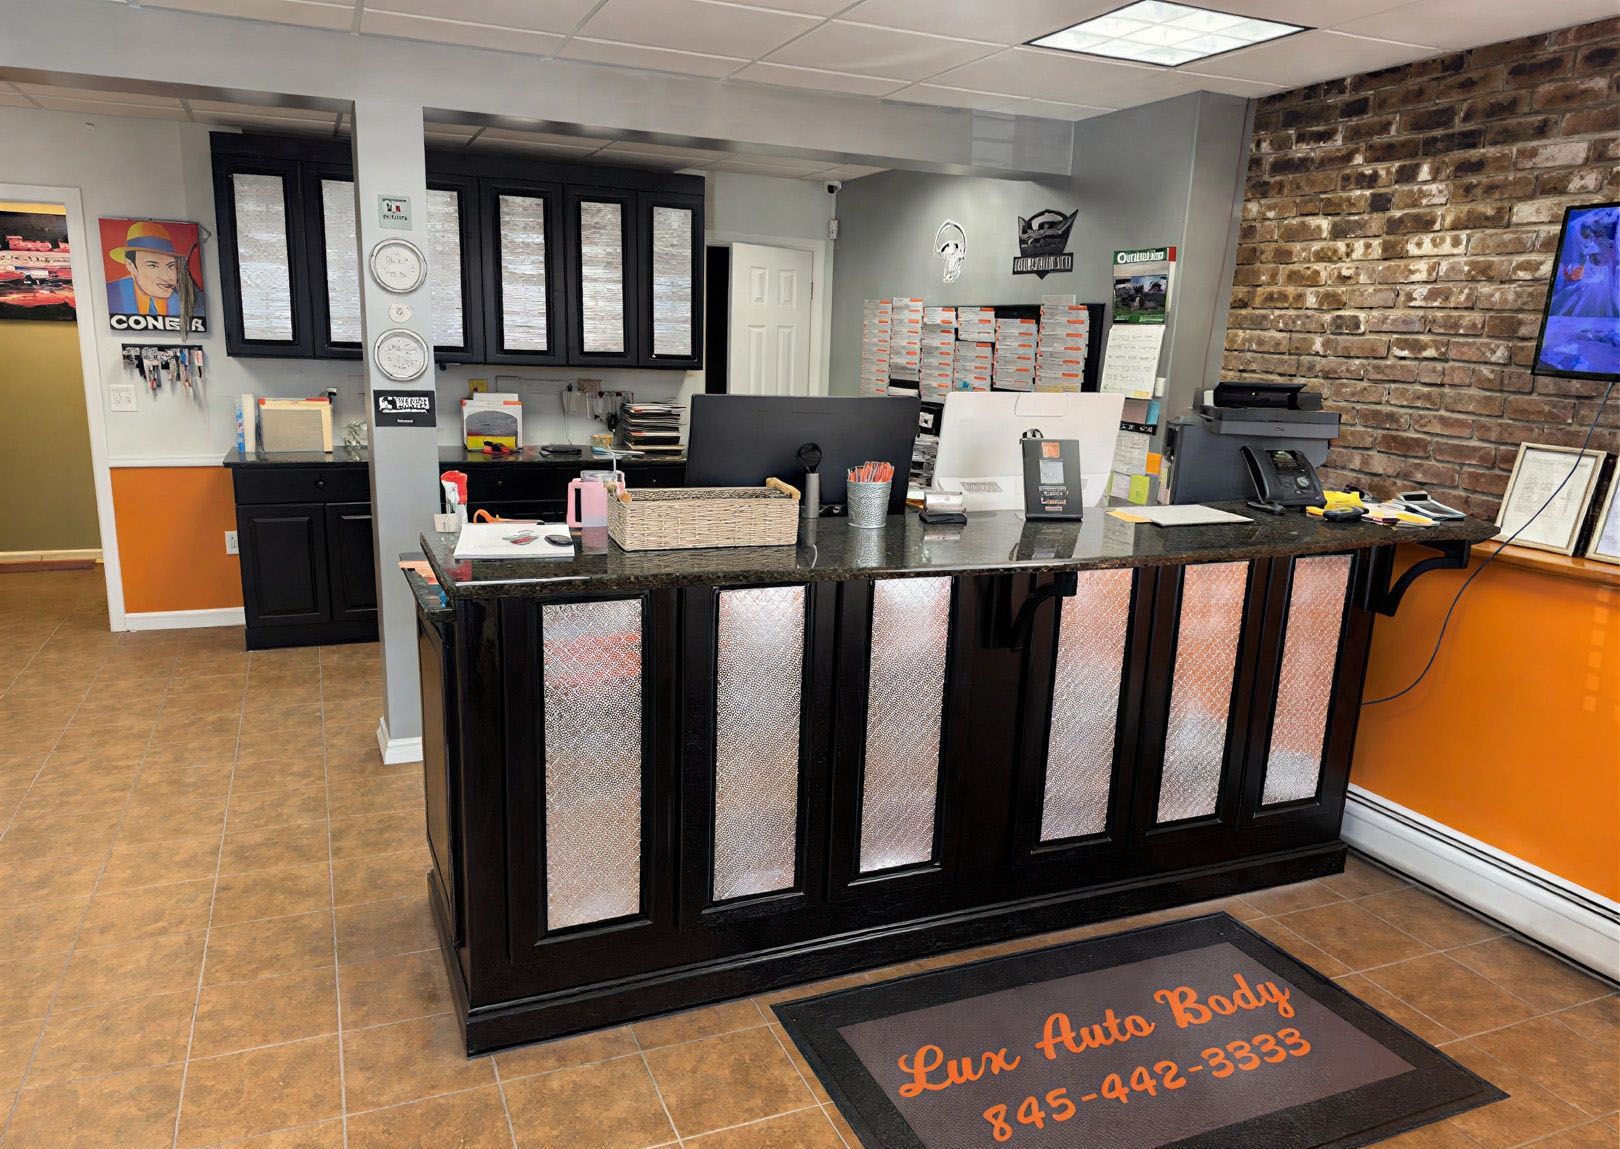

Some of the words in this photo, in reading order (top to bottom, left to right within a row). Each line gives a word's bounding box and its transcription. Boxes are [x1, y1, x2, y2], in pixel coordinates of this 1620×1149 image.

[898, 1044, 1022, 1098] Lux
[1034, 1008, 1156, 1061] Auto
[1153, 973, 1295, 1029] Body
[982, 1027, 1312, 1142] 845-442-3333
